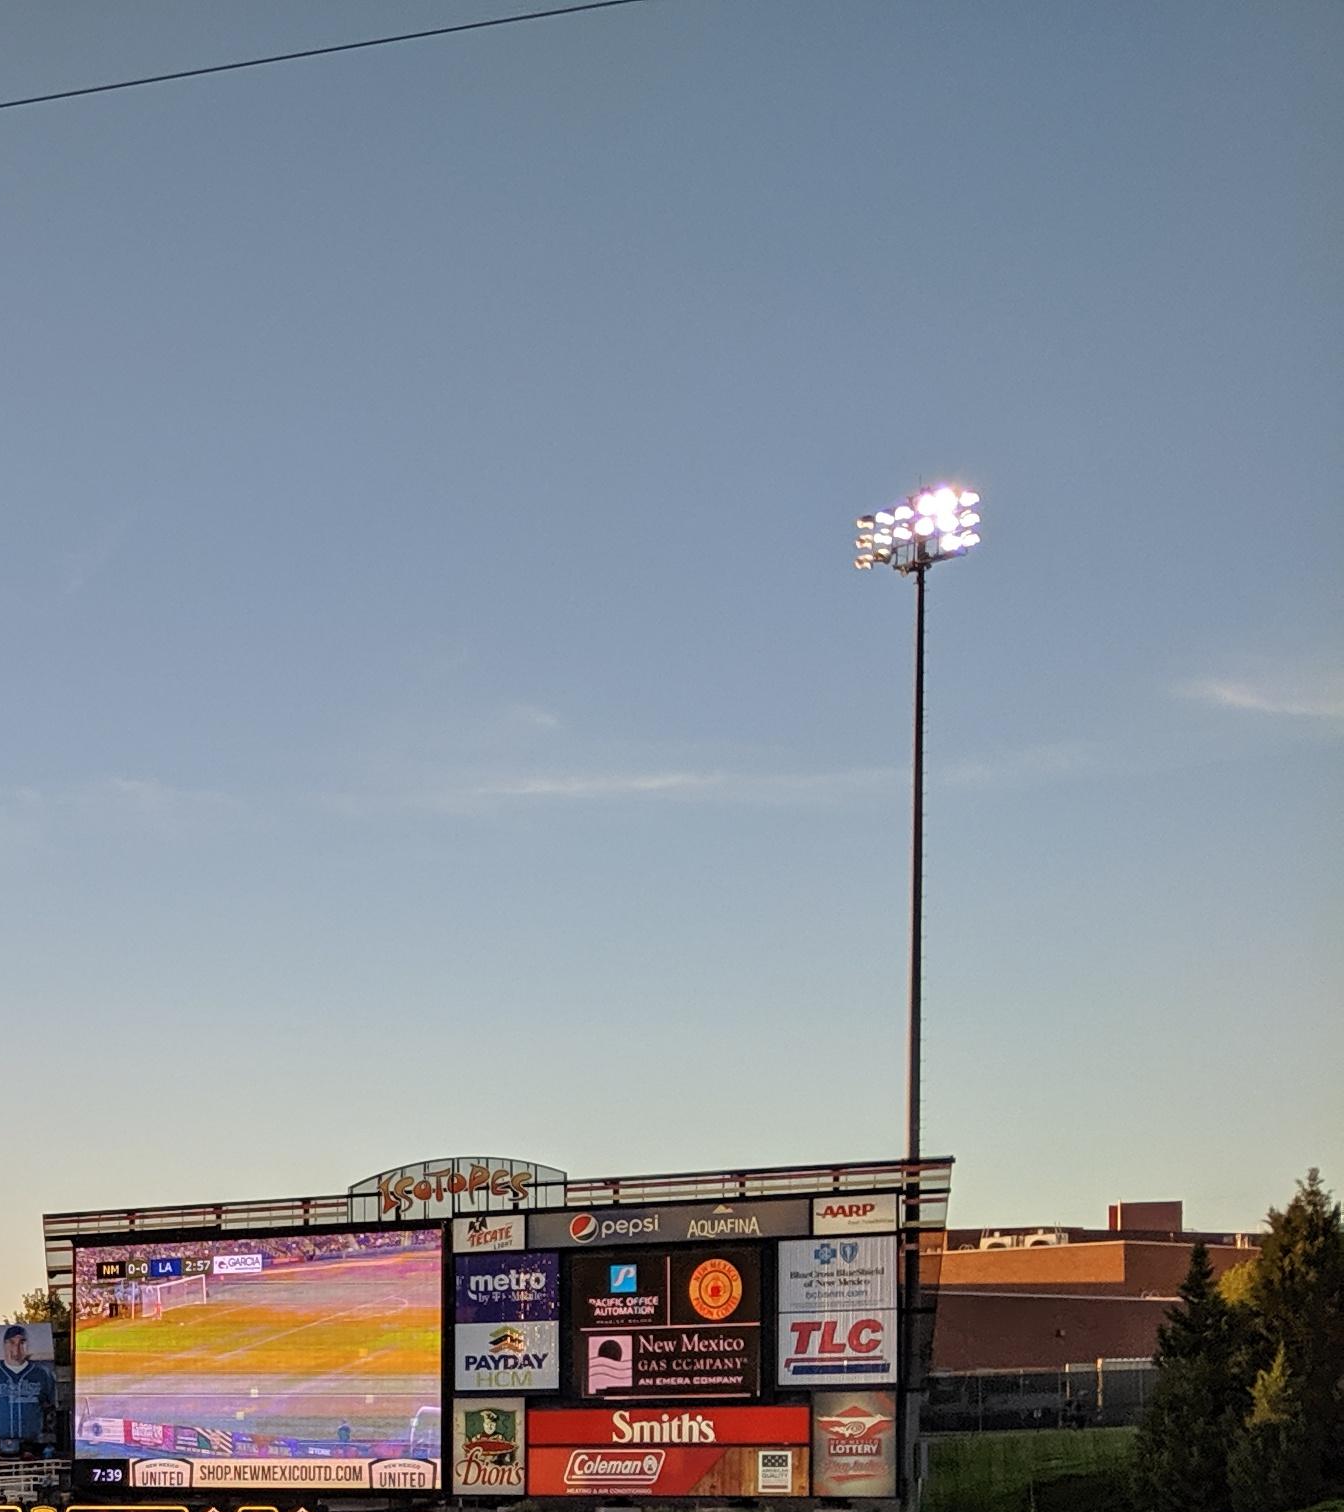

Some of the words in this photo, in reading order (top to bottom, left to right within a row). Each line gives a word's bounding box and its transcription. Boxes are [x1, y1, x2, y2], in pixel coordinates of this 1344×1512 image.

[816, 1203, 877, 1219] AARP
[601, 1213, 661, 1242] pepsi
[686, 1215, 762, 1239] AQUAFINA
[468, 1224, 513, 1248] TECATE
[493, 1240, 513, 1250] LIGHT
[102, 1264, 120, 1275] NM
[127, 1262, 149, 1275] 0-0
[158, 1261, 173, 1273] LA
[185, 1259, 211, 1272] 2:57
[228, 1256, 261, 1268] GARCIA
[469, 1269, 547, 1292] metro
[478, 1292, 491, 1304] by
[588, 1297, 624, 1307] PACIFIC
[628, 1296, 659, 1306] OFFICE
[594, 1305, 655, 1317] AUTOMATION
[638, 1334, 677, 1353] New
[681, 1333, 745, 1353] Mexico
[790, 1318, 885, 1355] TLC
[465, 1353, 549, 1371] PAYDAY
[638, 1359, 668, 1372] GAS
[476, 1371, 532, 1387] HCM
[639, 1377, 654, 1386] AN
[656, 1376, 690, 1386] EMERA
[693, 1375, 744, 1385] COMPANY
[612, 1410, 717, 1443] Smith's
[830, 1444, 879, 1454] LOTTERY
[199, 1464, 363, 1482] SHOP.NEWMEXICOUTD.COM
[456, 1447, 525, 1487] Dion's
[573, 1455, 641, 1475] Coleman
[92, 1468, 123, 1482] 7:39
[141, 1471, 184, 1486] UNITED
[379, 1472, 427, 1488] UNITED
